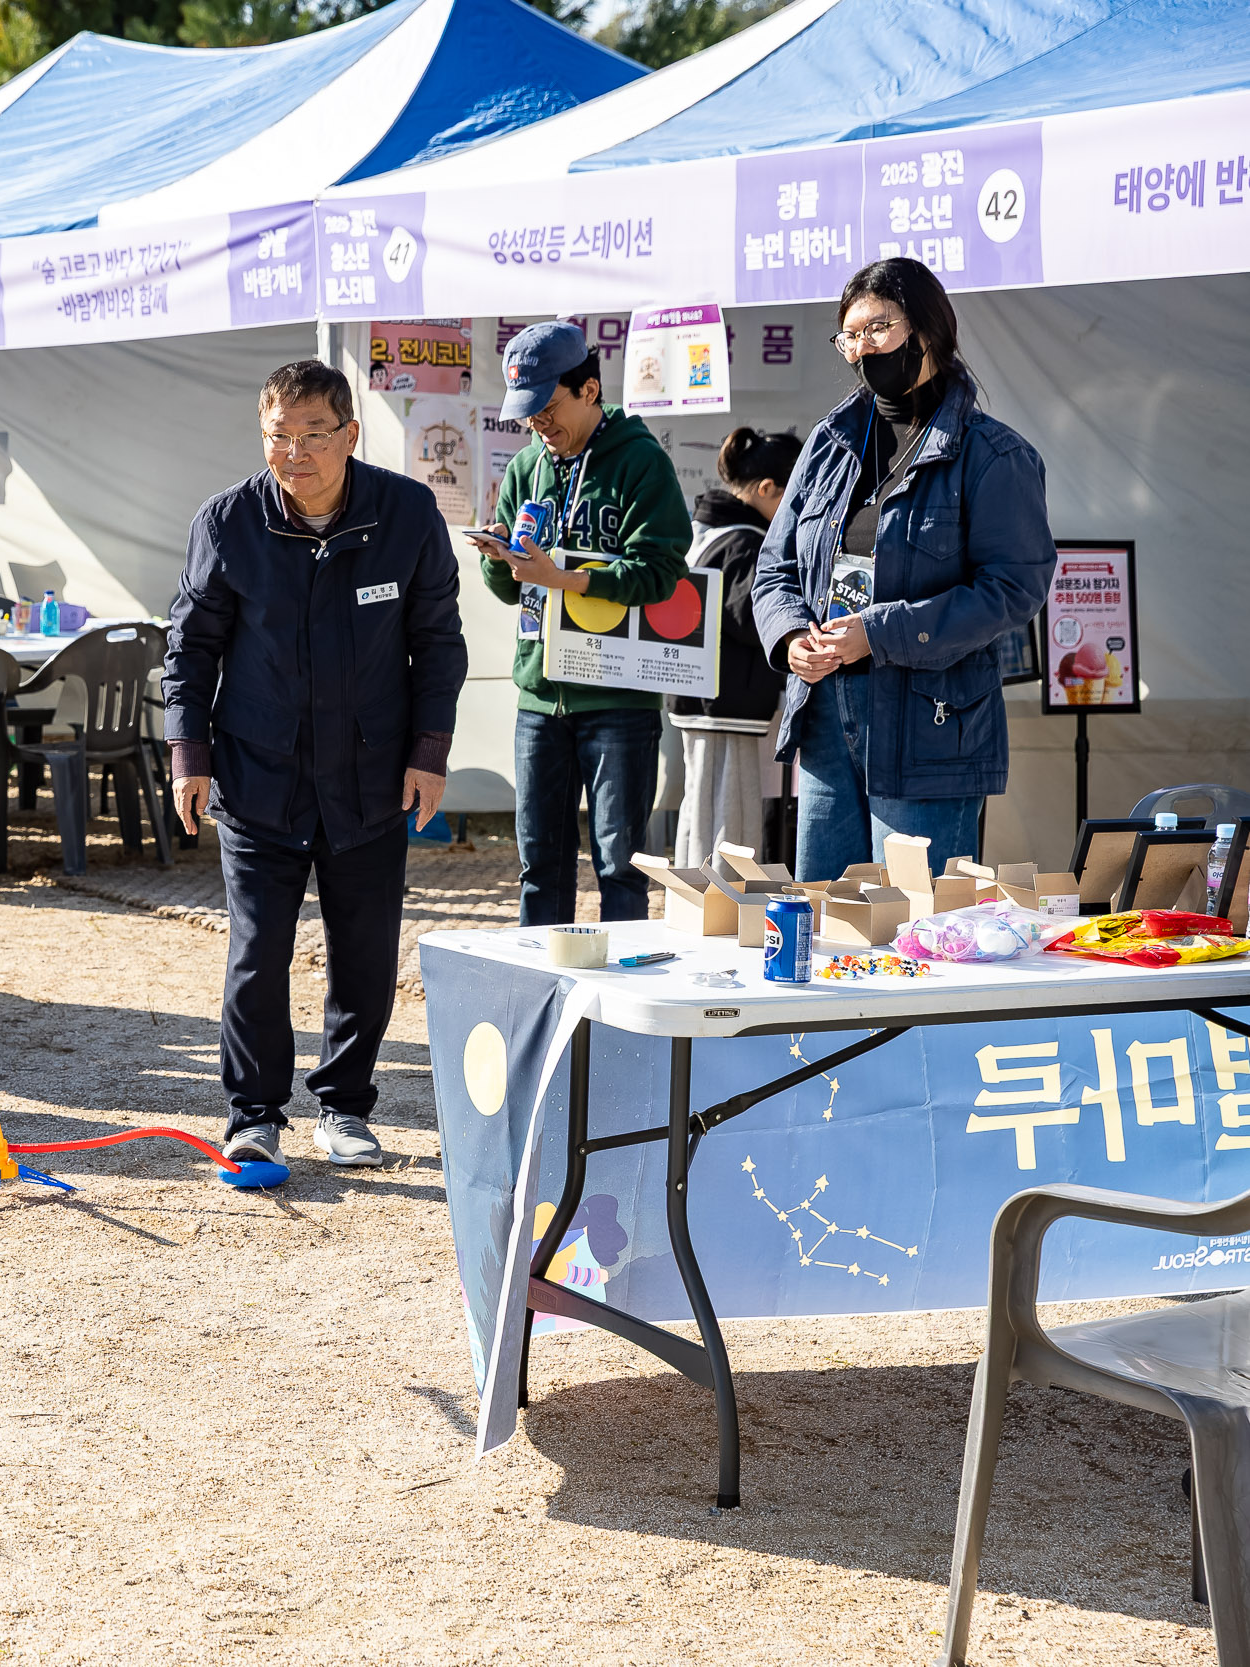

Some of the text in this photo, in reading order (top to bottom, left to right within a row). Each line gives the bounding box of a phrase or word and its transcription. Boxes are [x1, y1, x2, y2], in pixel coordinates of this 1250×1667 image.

[881, 149, 964, 188] 2025 광진
[1114, 155, 1250, 213] 태양에 반
[889, 193, 953, 234] 청소년
[985, 189, 1017, 221] 42
[330, 242, 370, 272] 청소년
[390, 243, 410, 264] 41
[489, 218, 652, 264] 양성평등 스테이션
[744, 223, 852, 271] 놀면 뭐하니
[60, 253, 100, 281] 고르고
[105, 247, 133, 278] 바다
[243, 262, 302, 299] 바람개비
[325, 275, 377, 306] 페스티벌
[139, 283, 168, 316] 함께
[370, 337, 471, 367] 2. 전시코너
[836, 582, 869, 605] STAFF
[585, 637, 602, 650] 흑점
[663, 647, 679, 659] 홍염
